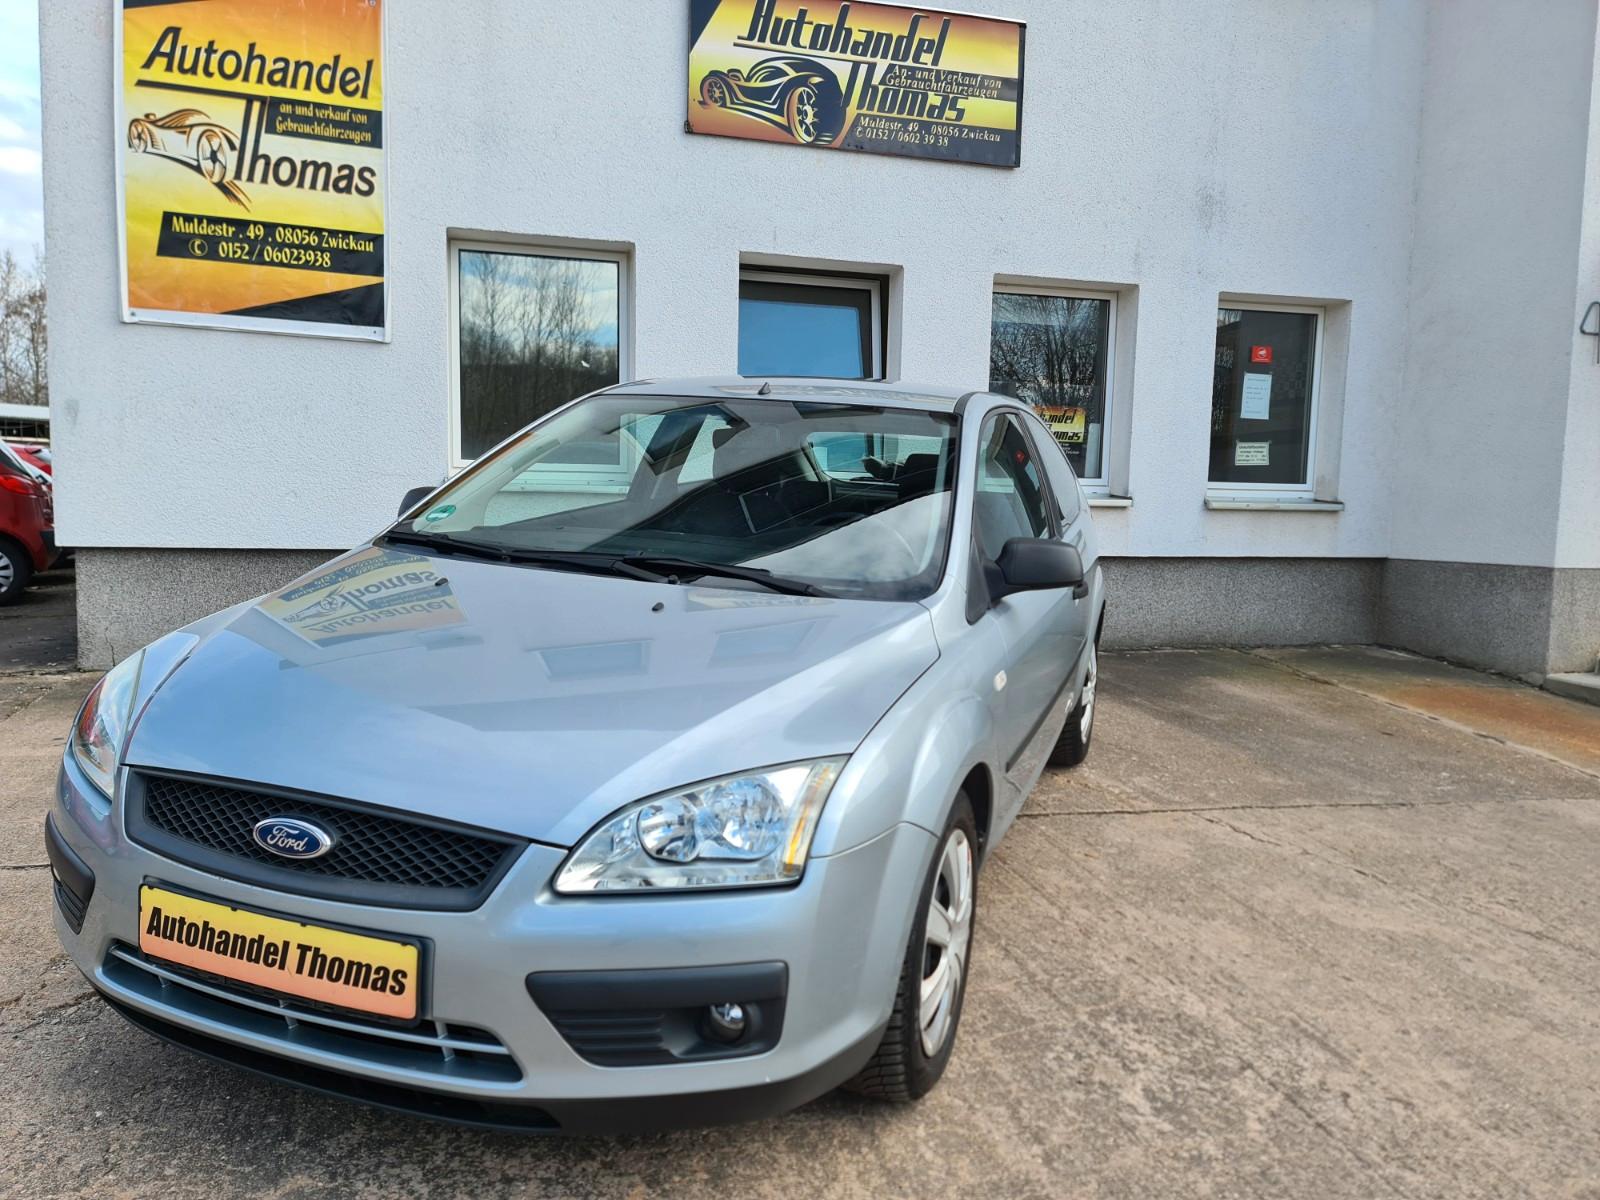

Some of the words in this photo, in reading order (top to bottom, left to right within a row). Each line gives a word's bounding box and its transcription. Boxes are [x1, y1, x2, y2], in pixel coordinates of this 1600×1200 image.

[737, 0, 951, 67] Autohandel
[140, 26, 374, 99] Autohandel
[843, 61, 969, 122] Thomas
[886, 74, 999, 98] Gebrauchtfahrzeugen
[915, 68, 936, 80] und
[940, 70, 982, 88] Verkauf
[984, 78, 1002, 89] von
[315, 106, 351, 122] verkauf
[351, 112, 368, 124] von
[859, 116, 904, 131] Muldestr.
[907, 122, 919, 134] 49
[931, 124, 960, 137] 08056
[961, 128, 1001, 142] Zwickau
[866, 128, 889, 140] 0152
[898, 132, 920, 144] 0602
[923, 135, 934, 145] 39
[938, 136, 949, 147] 38
[233, 95, 376, 197] Thomas
[246, 223, 264, 240] 49
[275, 226, 318, 247] 08056
[321, 231, 374, 252] Zwickau
[218, 241, 250, 259] 0152
[263, 245, 331, 268] 06023938
[267, 825, 309, 852] Ford
[146, 906, 290, 970] Autohandel
[294, 944, 408, 996] Thomas
